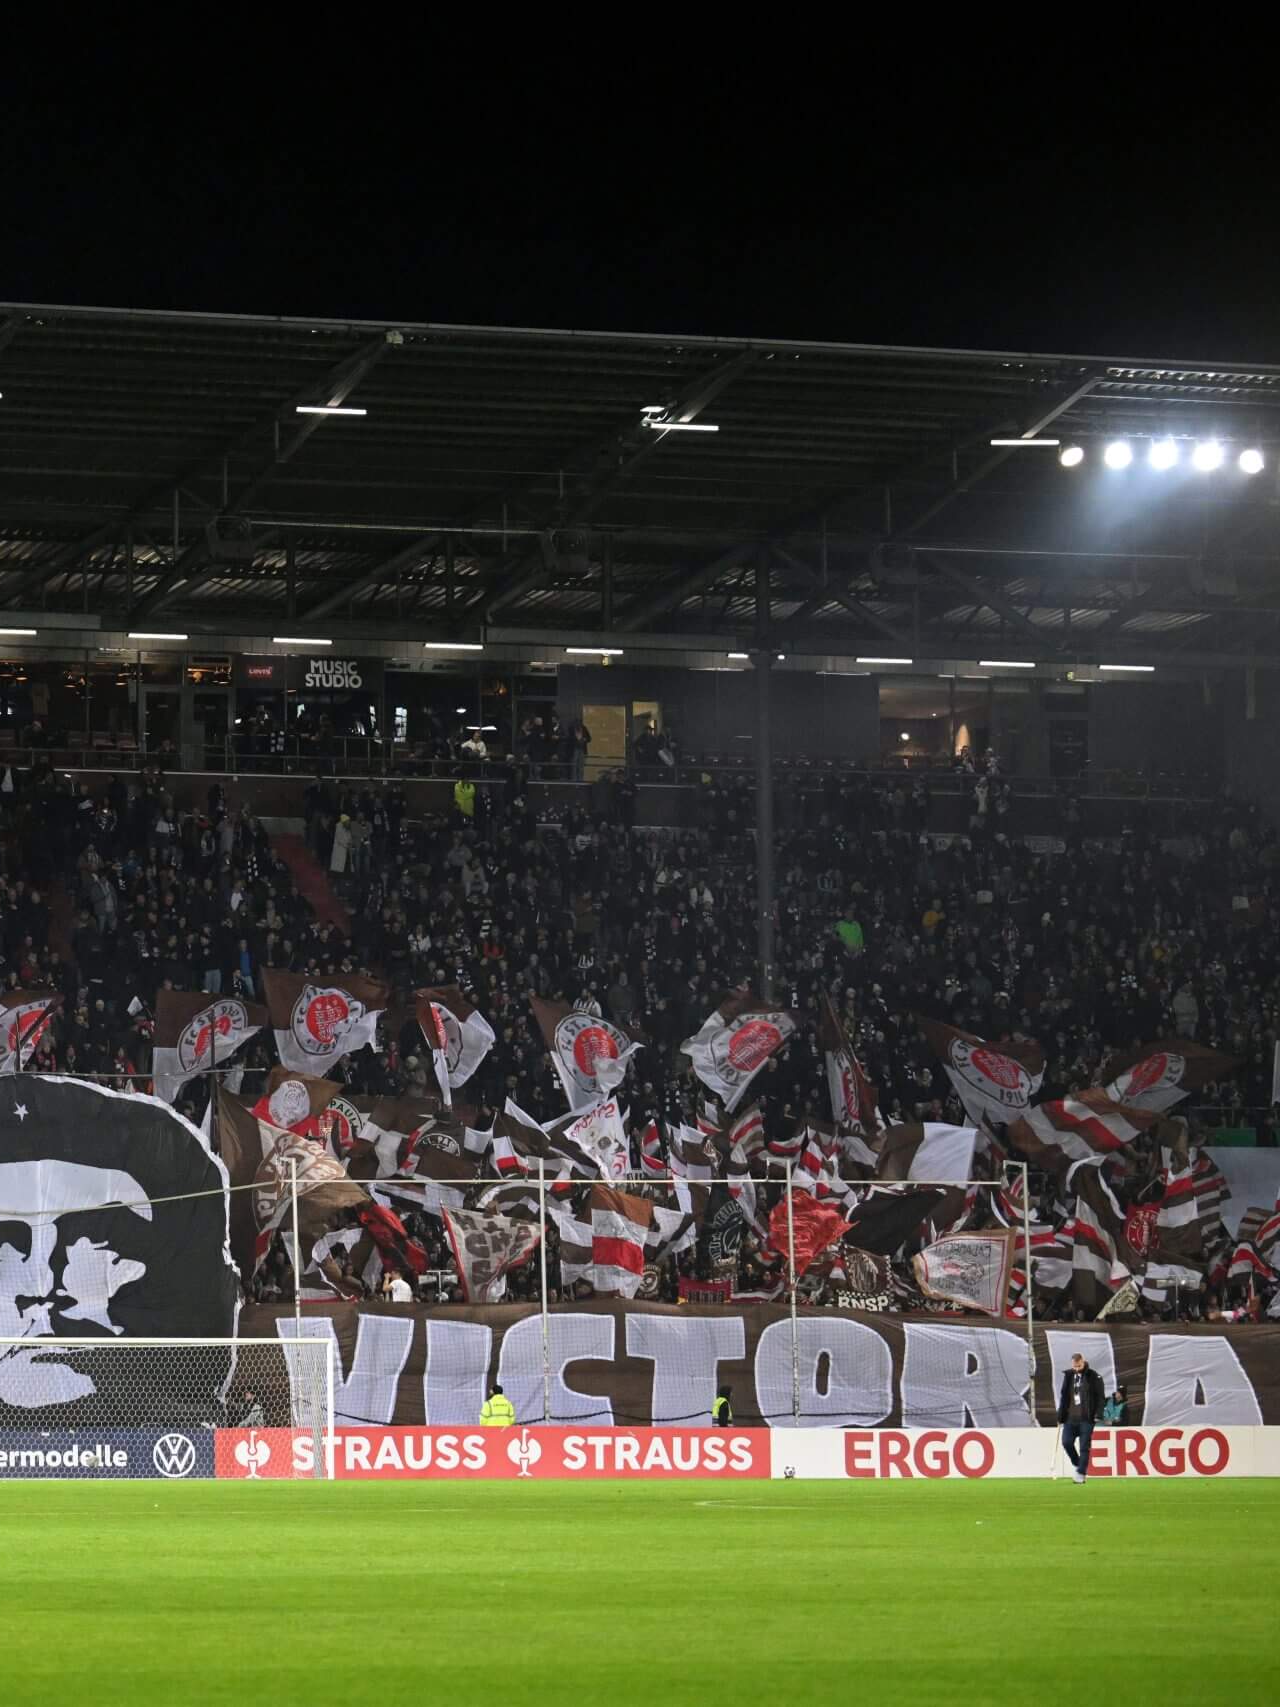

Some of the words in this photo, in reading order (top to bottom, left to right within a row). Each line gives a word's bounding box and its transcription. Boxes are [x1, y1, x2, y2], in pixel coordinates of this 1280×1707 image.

[305, 673, 362, 689] STUDIO
[310, 659, 358, 675] MUSIC
[275, 1312, 1264, 1427] VICTORIA
[291, 1434, 488, 1471] STRAUSS
[561, 1435, 754, 1471] STRAUSS
[844, 1429, 995, 1478] ERGO
[1086, 1428, 1230, 1477] ERGO
